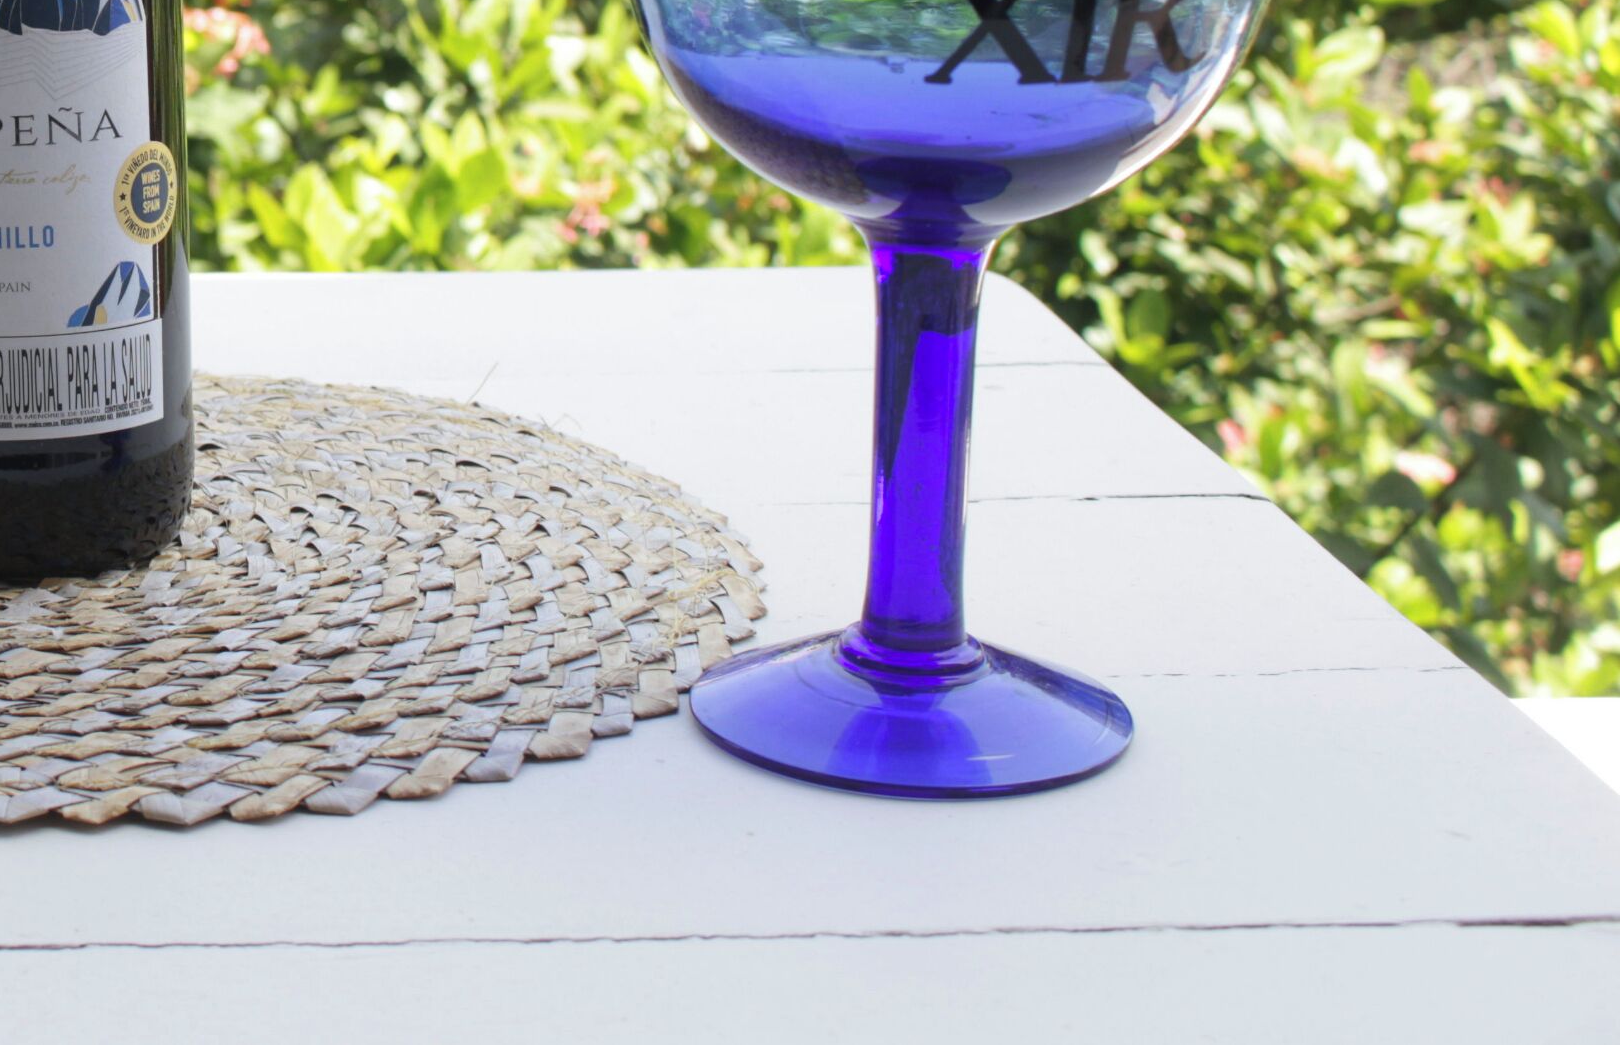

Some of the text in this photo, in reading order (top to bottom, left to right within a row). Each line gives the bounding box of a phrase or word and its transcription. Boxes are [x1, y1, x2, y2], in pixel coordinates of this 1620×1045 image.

[127, 150, 149, 174] VIÑEDO
[149, 149, 158, 161] DEL
[142, 184, 160, 201] FROM
[142, 198, 160, 215] SPAIN
[123, 215, 150, 240] VINEYARD
[150, 229, 157, 238] IN
[156, 222, 166, 234] THE
[67, 343, 100, 411] PARA
[104, 341, 118, 406] LA
[122, 333, 152, 404] SALUD
